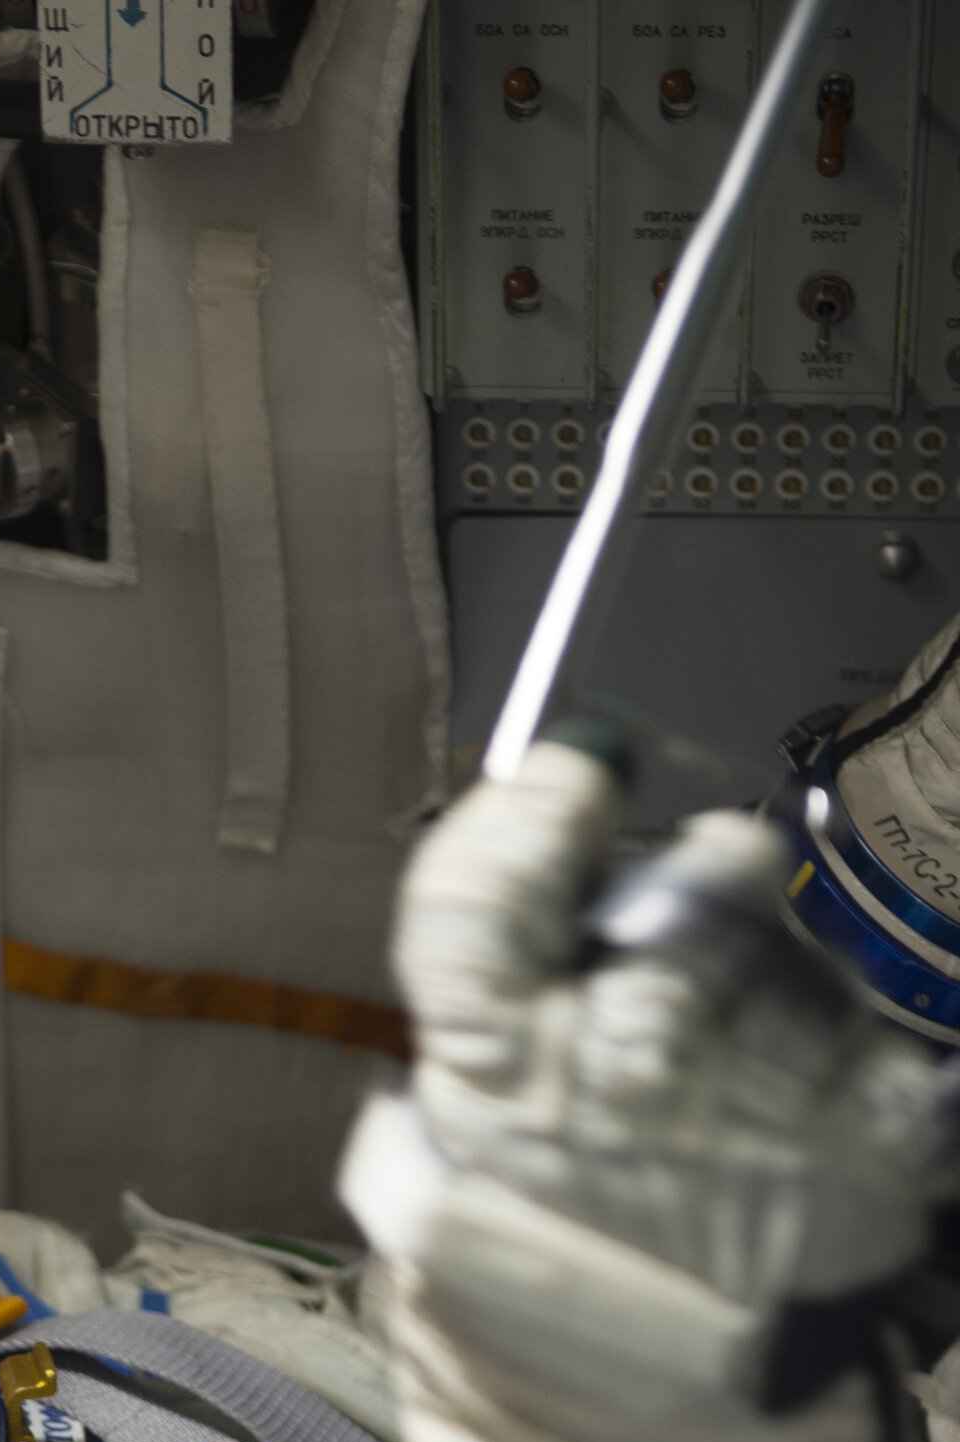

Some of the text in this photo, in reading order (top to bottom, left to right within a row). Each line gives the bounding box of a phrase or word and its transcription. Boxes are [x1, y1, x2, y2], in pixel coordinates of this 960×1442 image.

[74, 114, 199, 139] ОТКРЫТО
[491, 209, 554, 221] ПИТАНИЕ
[643, 211, 703, 223] ПИТАНИ
[801, 212, 862, 226] РАЗРЕШ
